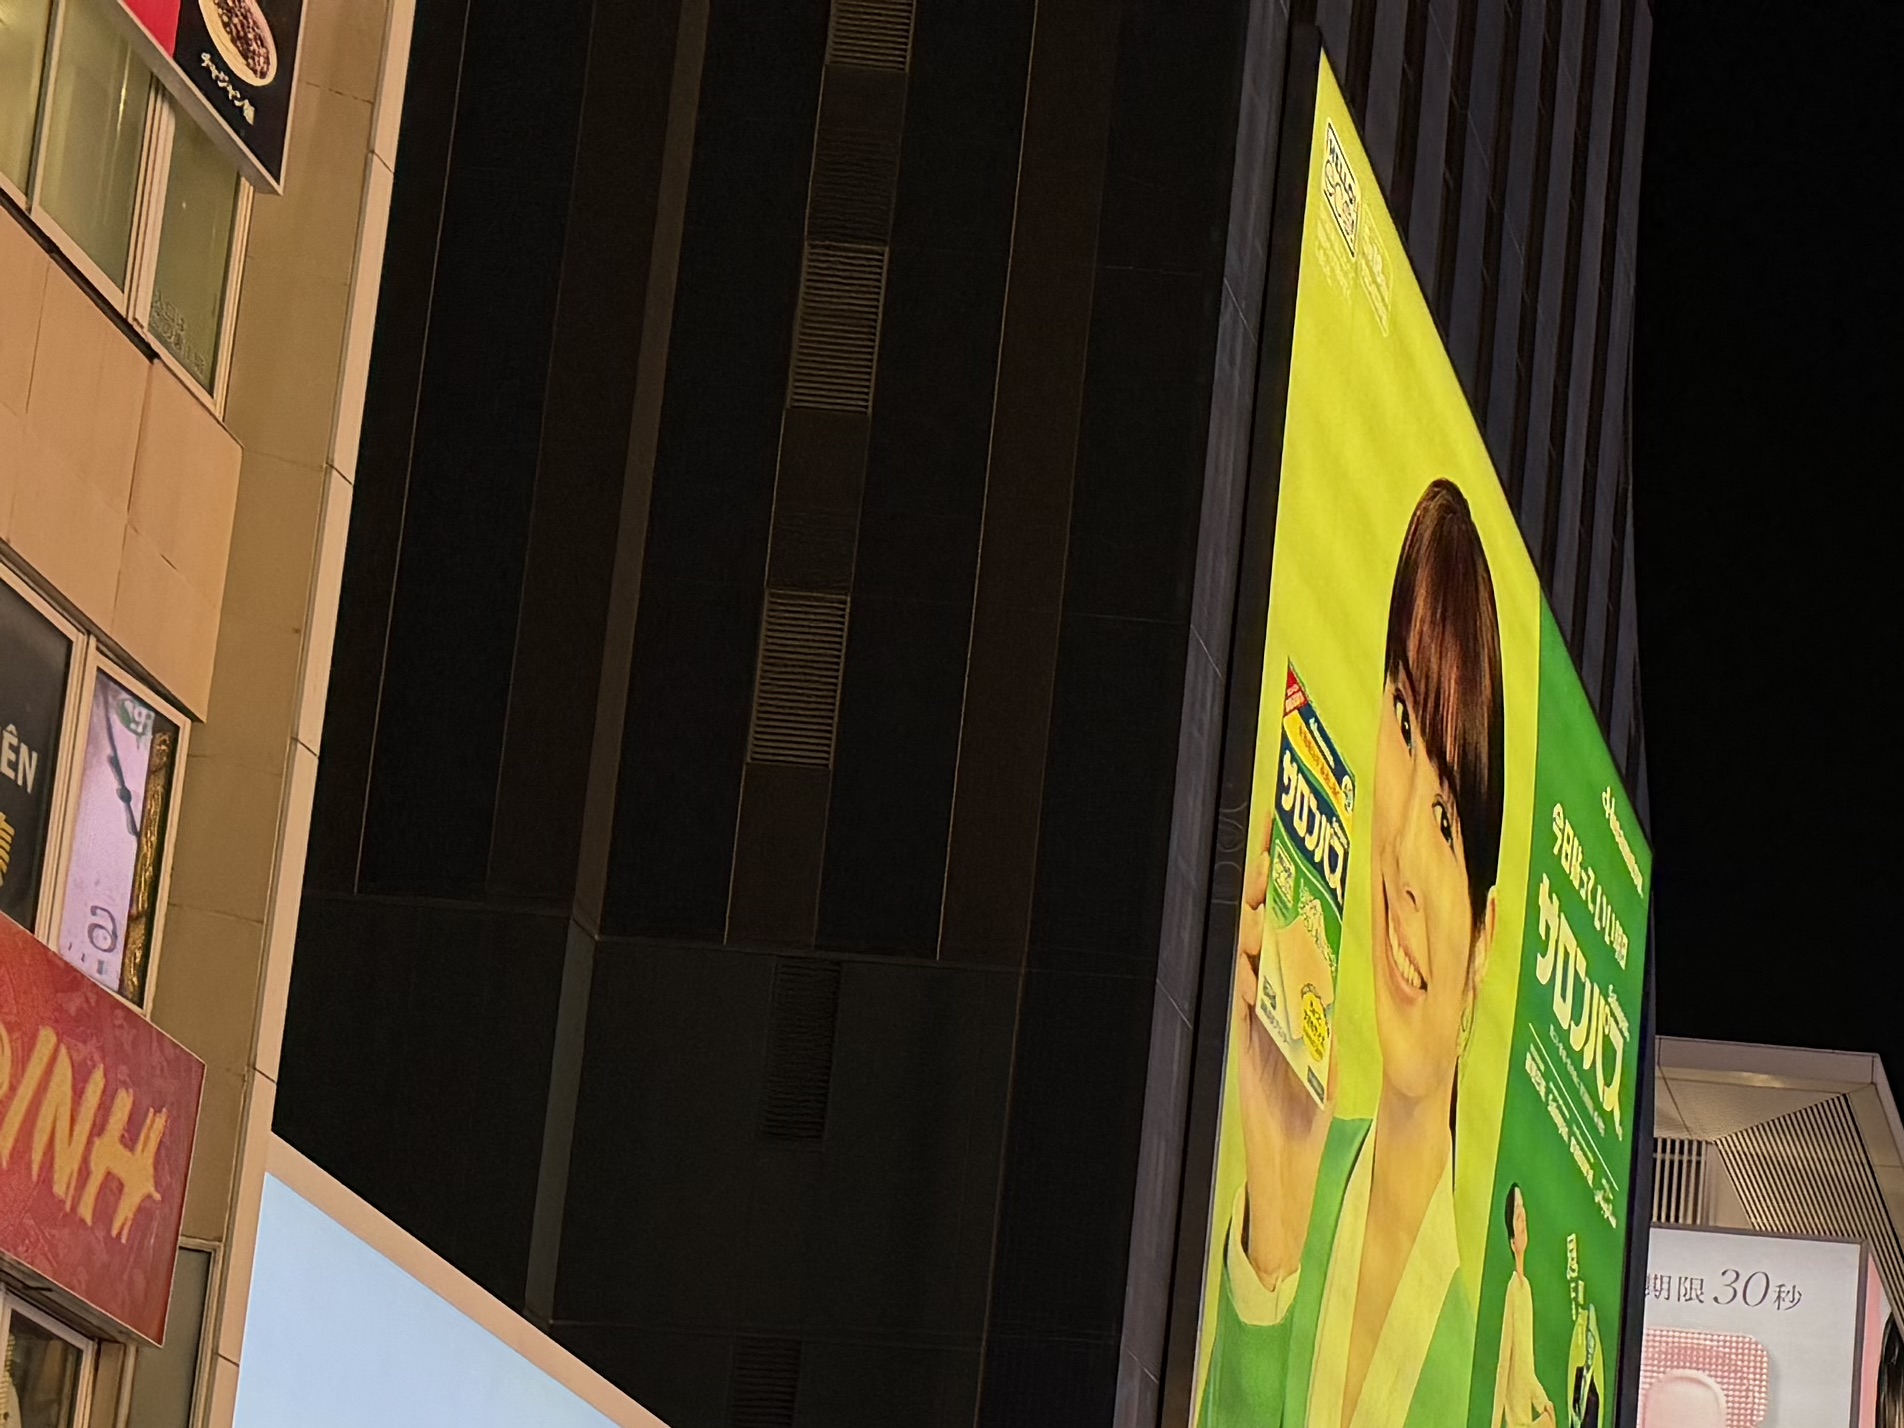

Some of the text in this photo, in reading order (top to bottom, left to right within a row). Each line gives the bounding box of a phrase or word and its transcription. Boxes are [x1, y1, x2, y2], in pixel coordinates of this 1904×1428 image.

[1535, 872, 1625, 1141] サロンパス
